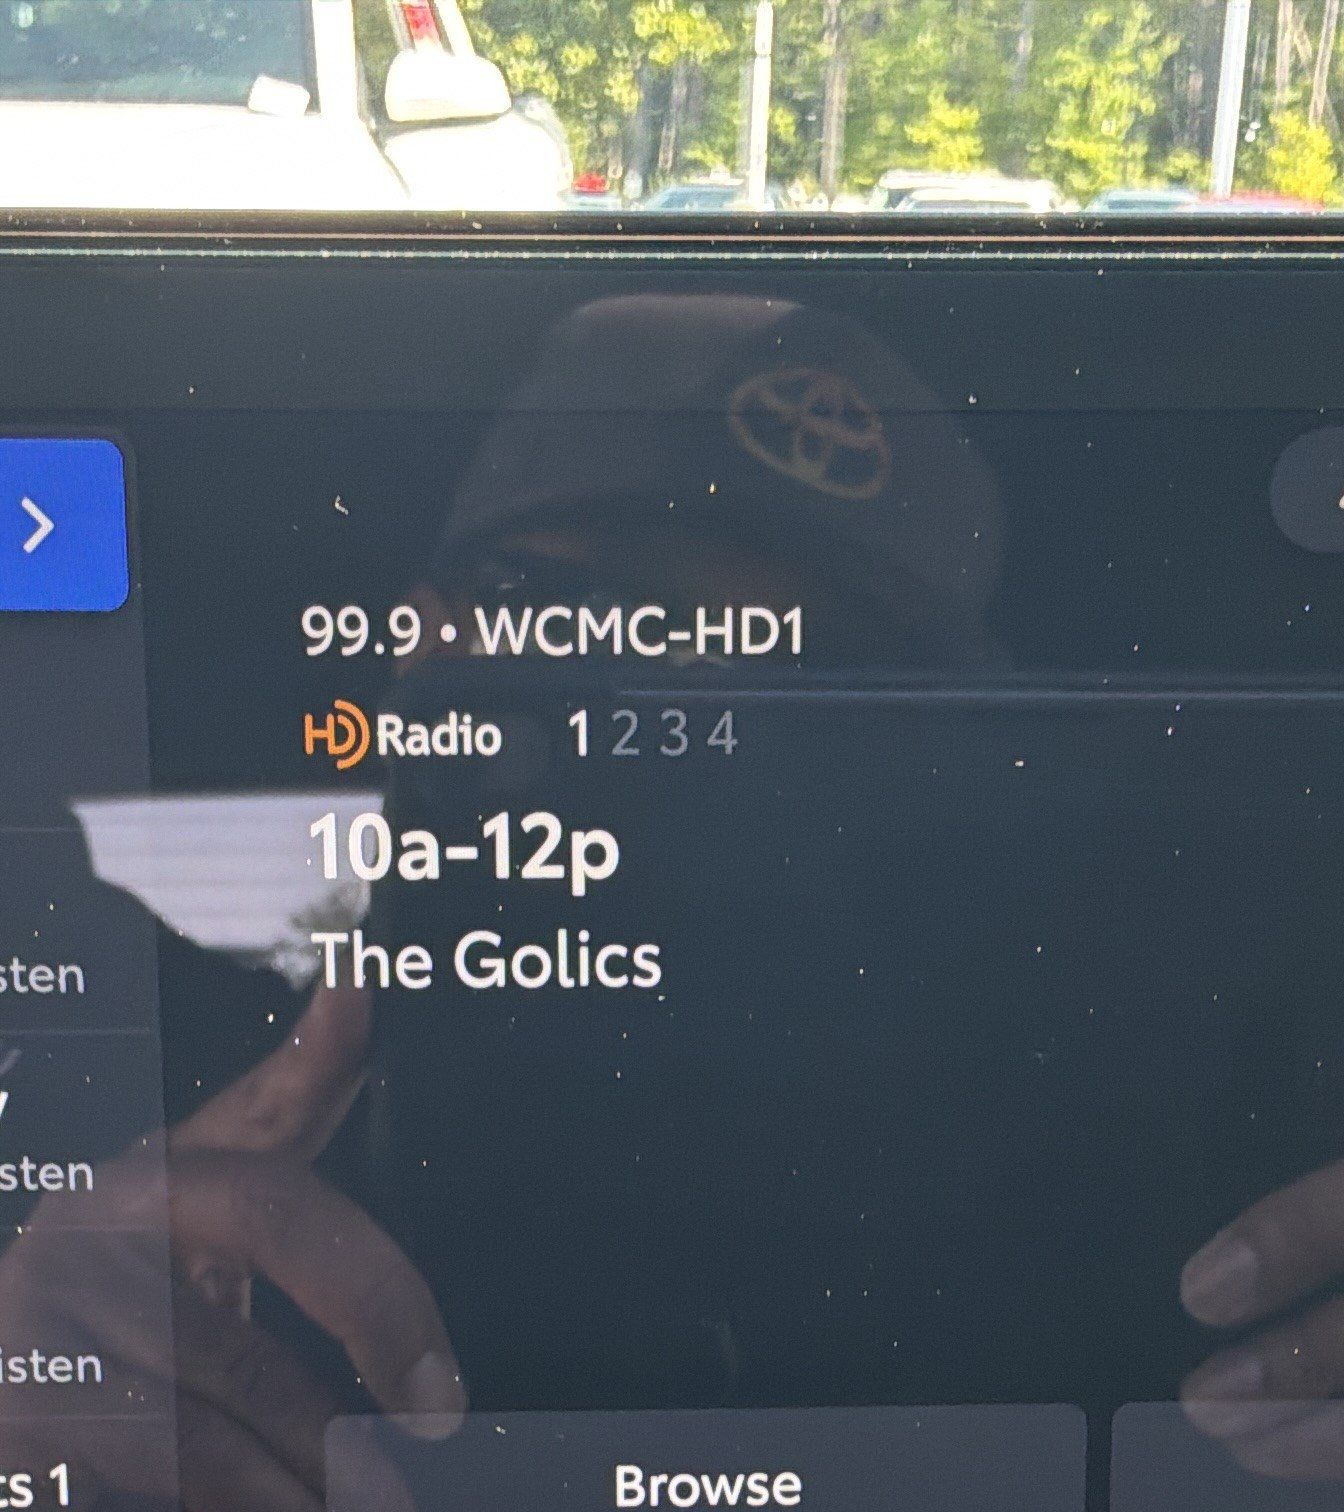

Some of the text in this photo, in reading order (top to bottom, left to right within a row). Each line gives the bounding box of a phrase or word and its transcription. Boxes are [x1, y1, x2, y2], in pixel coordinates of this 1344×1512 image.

[301, 605, 802, 657] 99.9 WCMC-HD1
[376, 710, 502, 756] Radio
[569, 708, 739, 757] 1 2 3 4
[309, 811, 620, 897] 10a-12p
[311, 928, 662, 989] The Golics
[49, 1463, 69, 1506] 1
[615, 1464, 802, 1508] Browse
